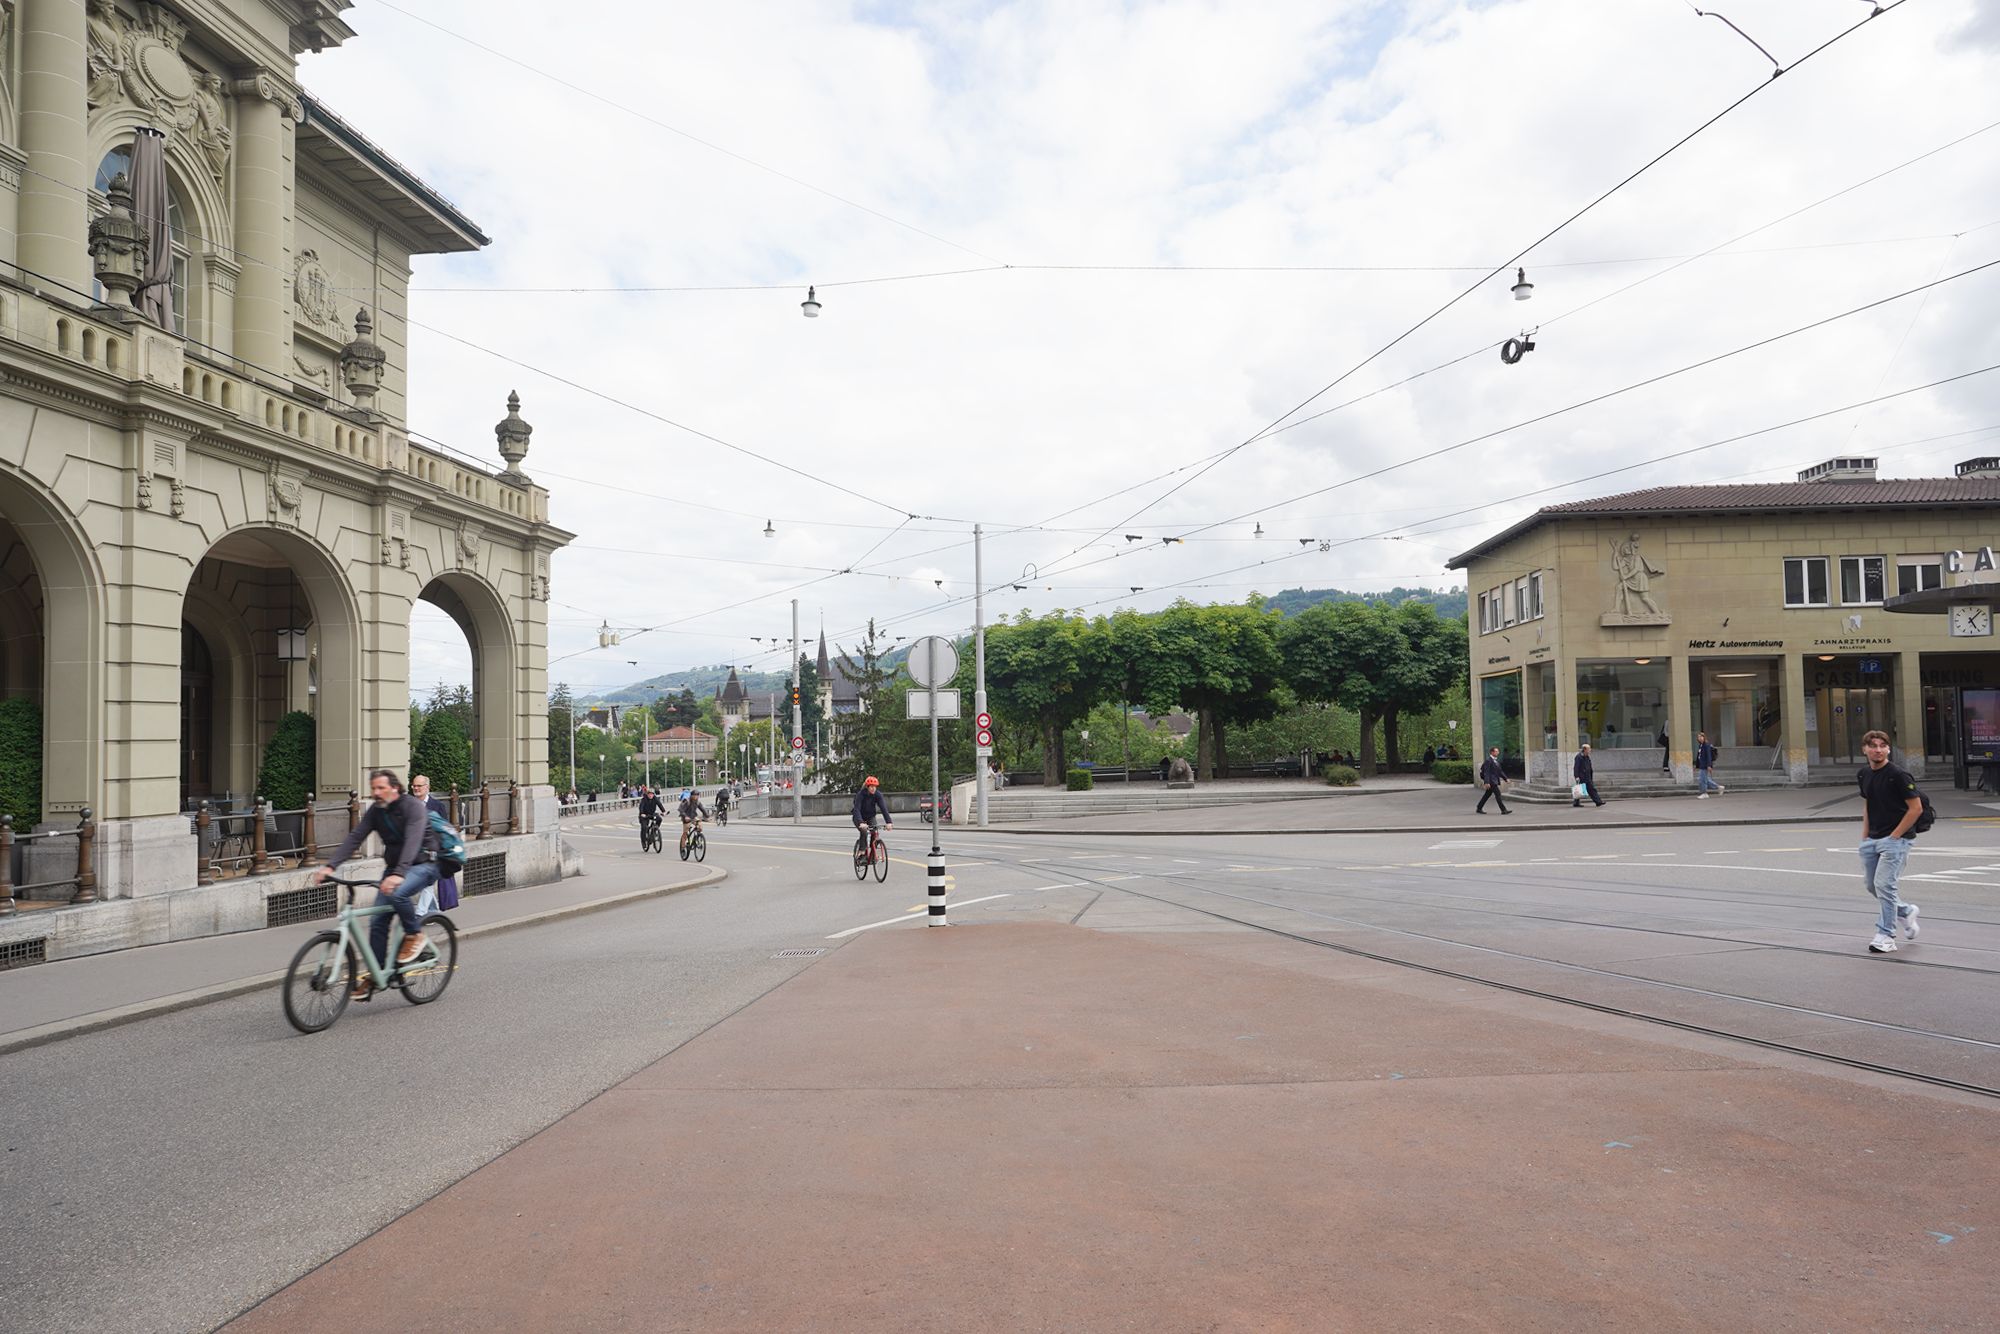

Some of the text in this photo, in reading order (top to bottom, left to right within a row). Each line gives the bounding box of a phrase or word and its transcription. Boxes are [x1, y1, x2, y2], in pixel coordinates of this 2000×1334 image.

[1319, 543, 1330, 551] 20
[1688, 639, 1784, 649] Hertz Autovermietung
[1869, 662, 1878, 671] P
[1815, 671, 1889, 686] CASINO
[1921, 670, 1984, 683] ARKING
[1577, 699, 1600, 712] rtz
